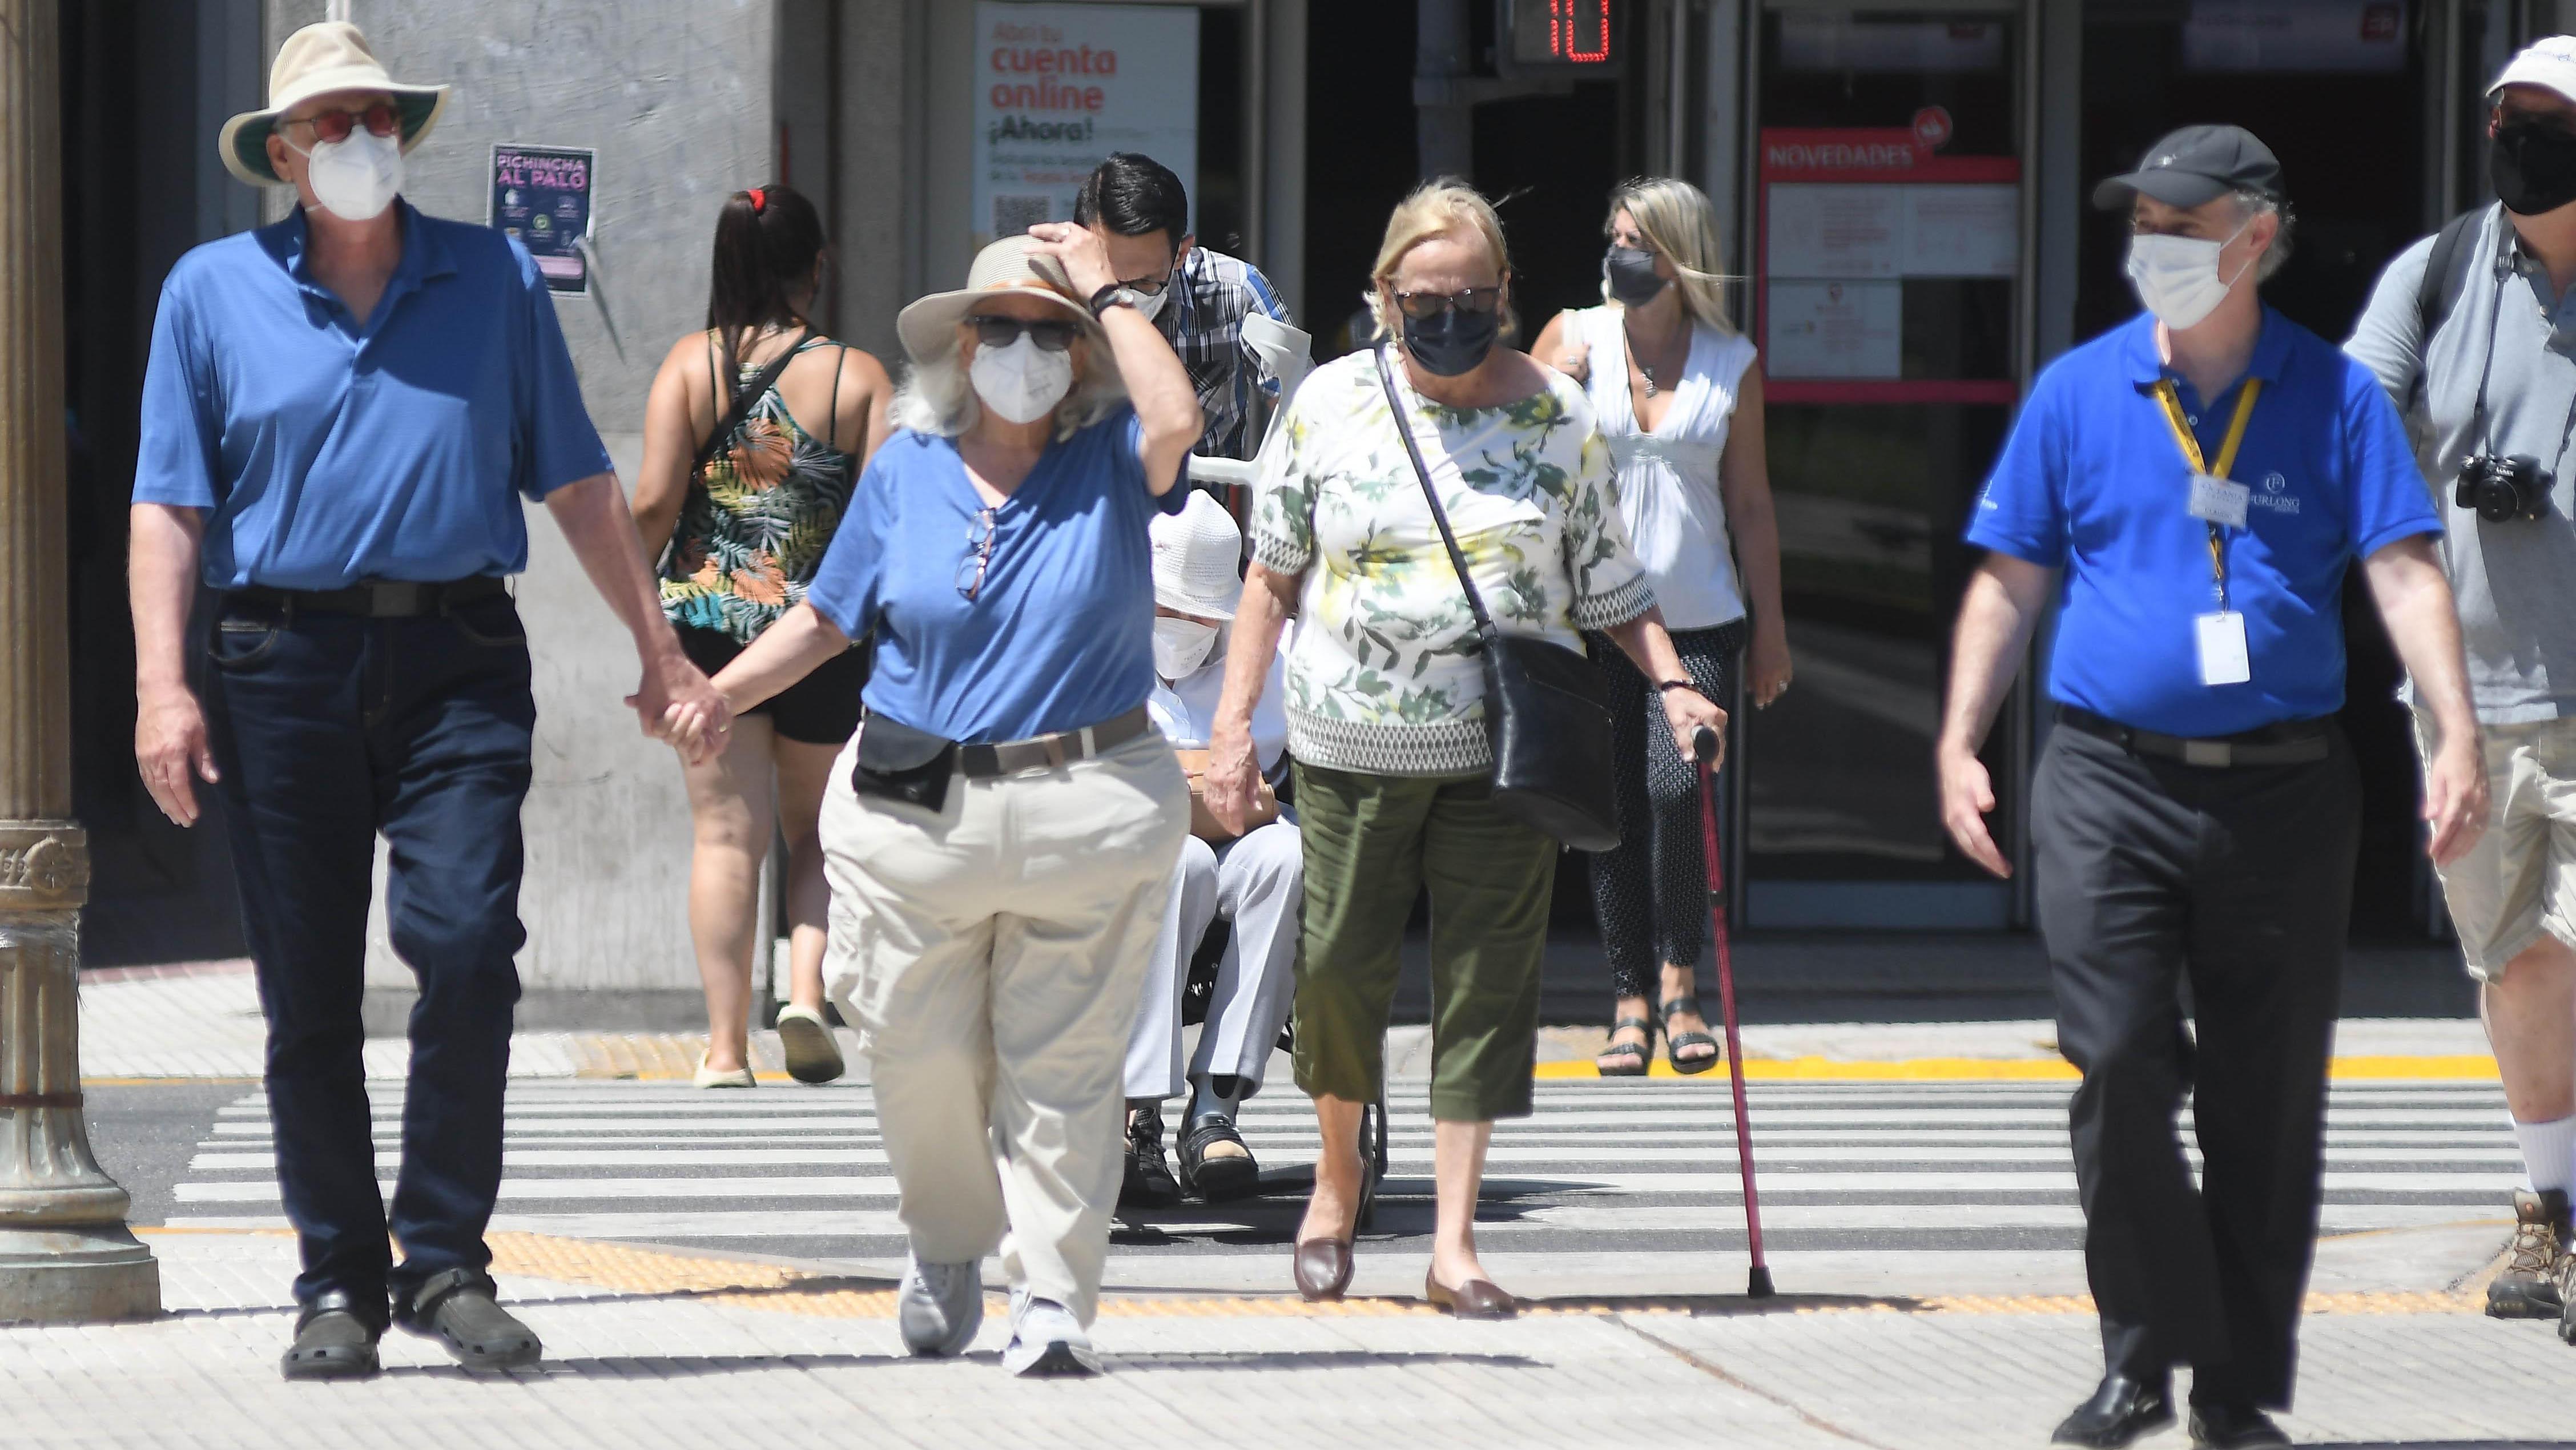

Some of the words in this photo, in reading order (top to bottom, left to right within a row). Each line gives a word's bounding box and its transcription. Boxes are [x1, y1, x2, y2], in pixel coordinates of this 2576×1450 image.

[1550, 0, 1609, 62] 10
[991, 43, 1117, 75] cuenta
[991, 76, 1105, 110] online
[989, 116, 1093, 145] ¡Ahora!
[497, 155, 585, 171] PICHINCHA
[1769, 144, 1913, 168] NOVEDADES
[497, 170, 525, 185] AL
[531, 170, 586, 191] PALO
[2251, 494, 2300, 508] URLONG
